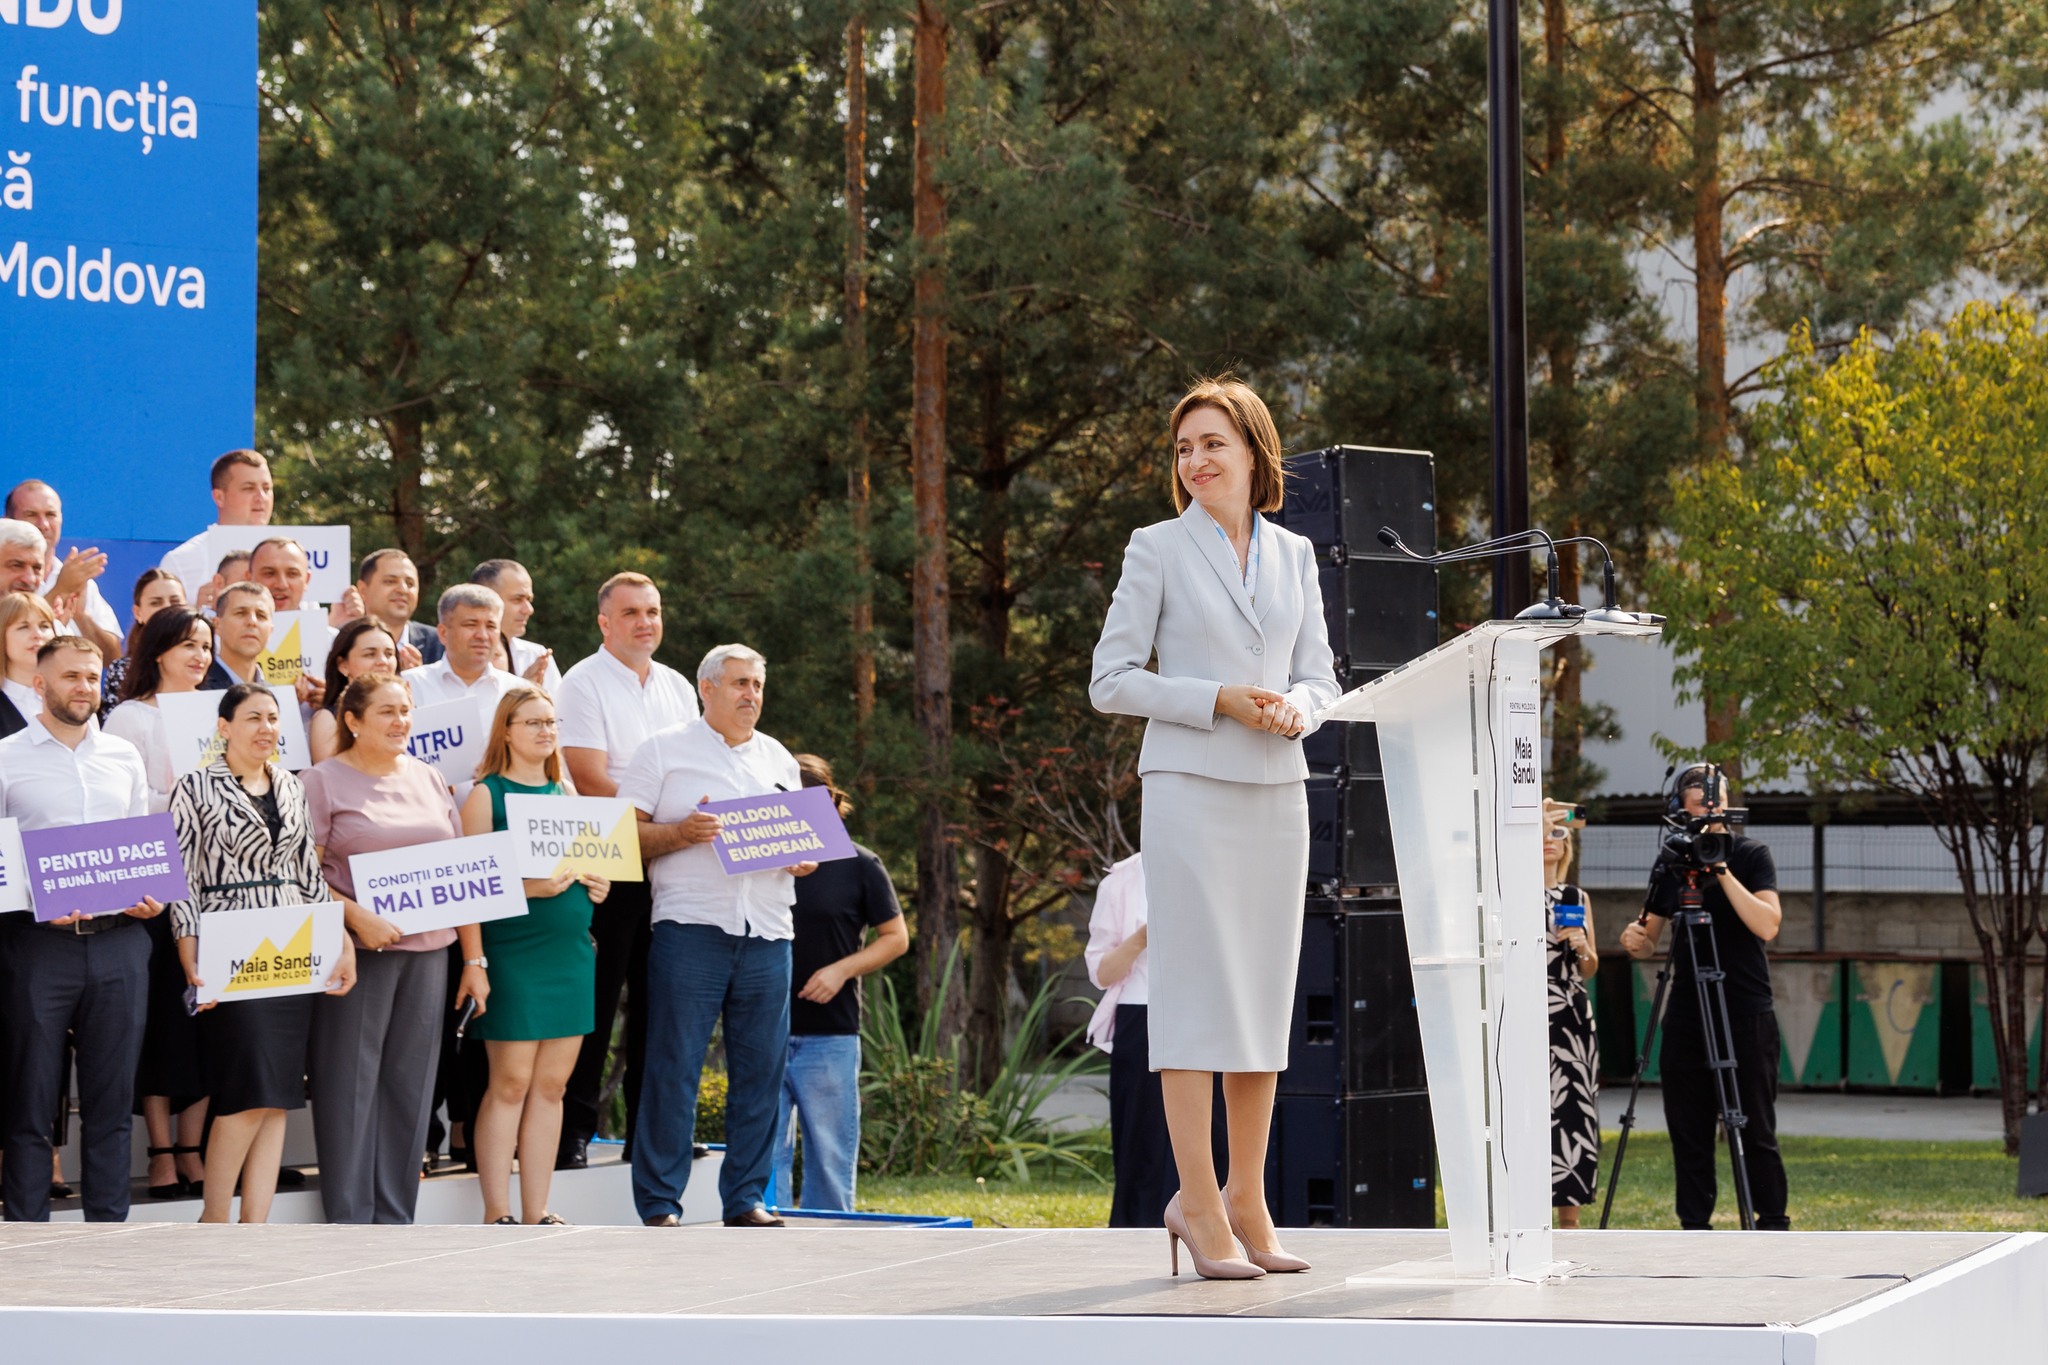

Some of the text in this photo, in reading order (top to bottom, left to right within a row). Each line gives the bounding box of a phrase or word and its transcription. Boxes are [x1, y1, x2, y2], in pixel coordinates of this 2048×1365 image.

[16, 64, 198, 155] funcția
[0, 240, 206, 309] Moldova
[267, 654, 312, 671] Sandu
[1514, 736, 1532, 759] Maia
[1513, 762, 1535, 784] Sandu
[527, 819, 601, 837] PENTRU
[740, 819, 813, 842] UNIUNEA
[38, 840, 167, 874] PENTRU PACE
[530, 840, 623, 860] MOLDOVA
[727, 832, 825, 862] EUROPEANĂ
[42, 862, 171, 894] ȘI BUNĂ ÎNȚELEGERE
[368, 855, 499, 889] CONDIȚII DE VIAȚĂ
[372, 876, 504, 915] MAI BUNE
[230, 952, 322, 975] Maia Sandu
[230, 969, 320, 984] PENTRU MOLDOVA
